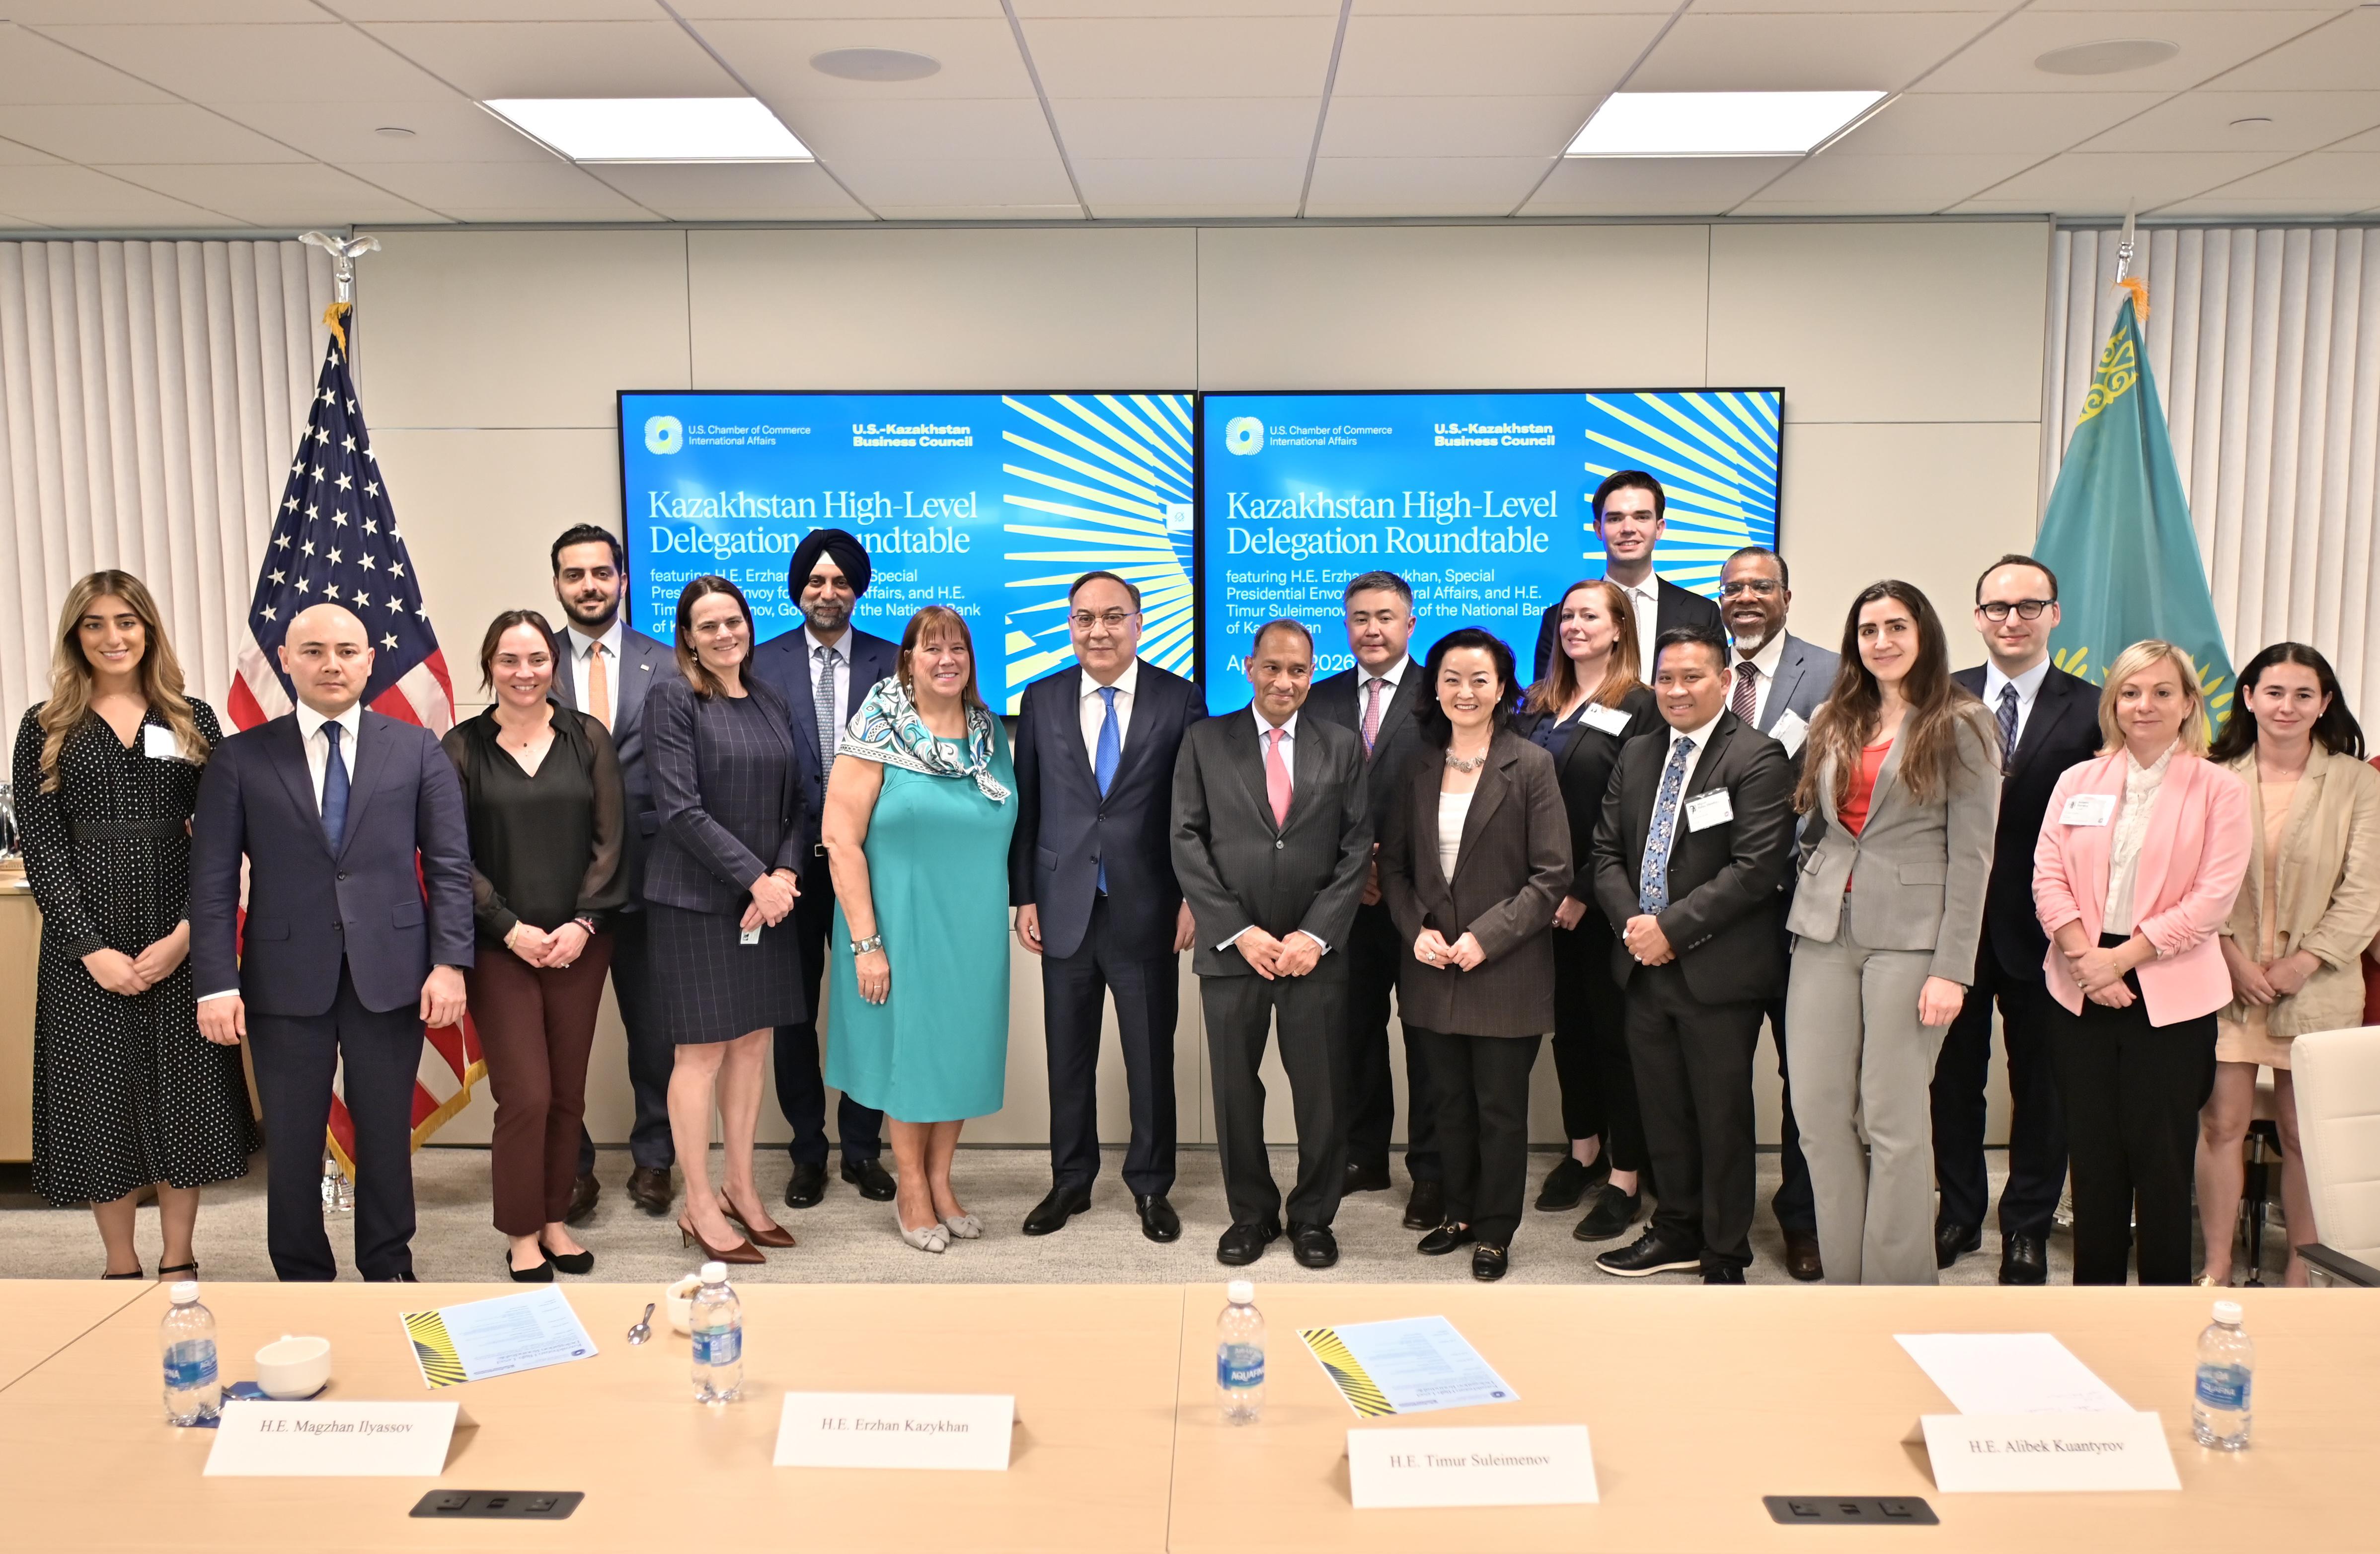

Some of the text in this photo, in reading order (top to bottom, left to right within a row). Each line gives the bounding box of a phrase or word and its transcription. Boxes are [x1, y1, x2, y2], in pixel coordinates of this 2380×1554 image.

[689, 425, 811, 435] U.S. Chamber of Commerce
[852, 424, 971, 435] U.S.-Kazakhstan
[1270, 425, 1393, 435] U.S. Chamber of Commerce
[1435, 423, 1553, 434] U.S.-Kazakhstan
[689, 436, 776, 446] International Affairs
[853, 436, 973, 447] Business Council
[1270, 436, 1358, 446] International Affairs
[1435, 436, 1556, 447] Business Council
[648, 491, 979, 525] Kazakhstan High-Level
[1227, 490, 1558, 525] Kazakhstan High-Level
[650, 526, 970, 560] Delegation ndtable
[1227, 527, 1549, 560] Delegation Roundtable
[715, 569, 742, 582] H.E.
[870, 569, 918, 585] Special
[1226, 570, 1287, 585] featuring
[1291, 569, 1318, 583] H.E.
[1445, 569, 1495, 585] Special
[737, 586, 774, 602] nvoy
[909, 586, 934, 600] and
[938, 586, 965, 599] H.E.
[1227, 586, 1345, 602] Presidential Envo
[1434, 586, 1481, 601] Affairs,
[1484, 586, 1510, 599] and
[1514, 586, 1542, 599] H.E.
[860, 603, 882, 617] the
[1226, 604, 1266, 618] Timur
[1418, 603, 1433, 617] of
[1436, 603, 1458, 617] the
[1461, 603, 1518, 617] National
[1523, 603, 1552, 617] Ban
[652, 620, 666, 633] of
[1226, 621, 1240, 634] of
[260, 1420, 413, 1436] H.E. Magzhan Ilyassov
[822, 1418, 969, 1435] H.E. Erzhan Kazykhan
[1969, 1440, 2124, 1455] H.E. Alibek Kuantyrov
[1390, 1454, 1550, 1468] H.E. Timur Suleimenov
